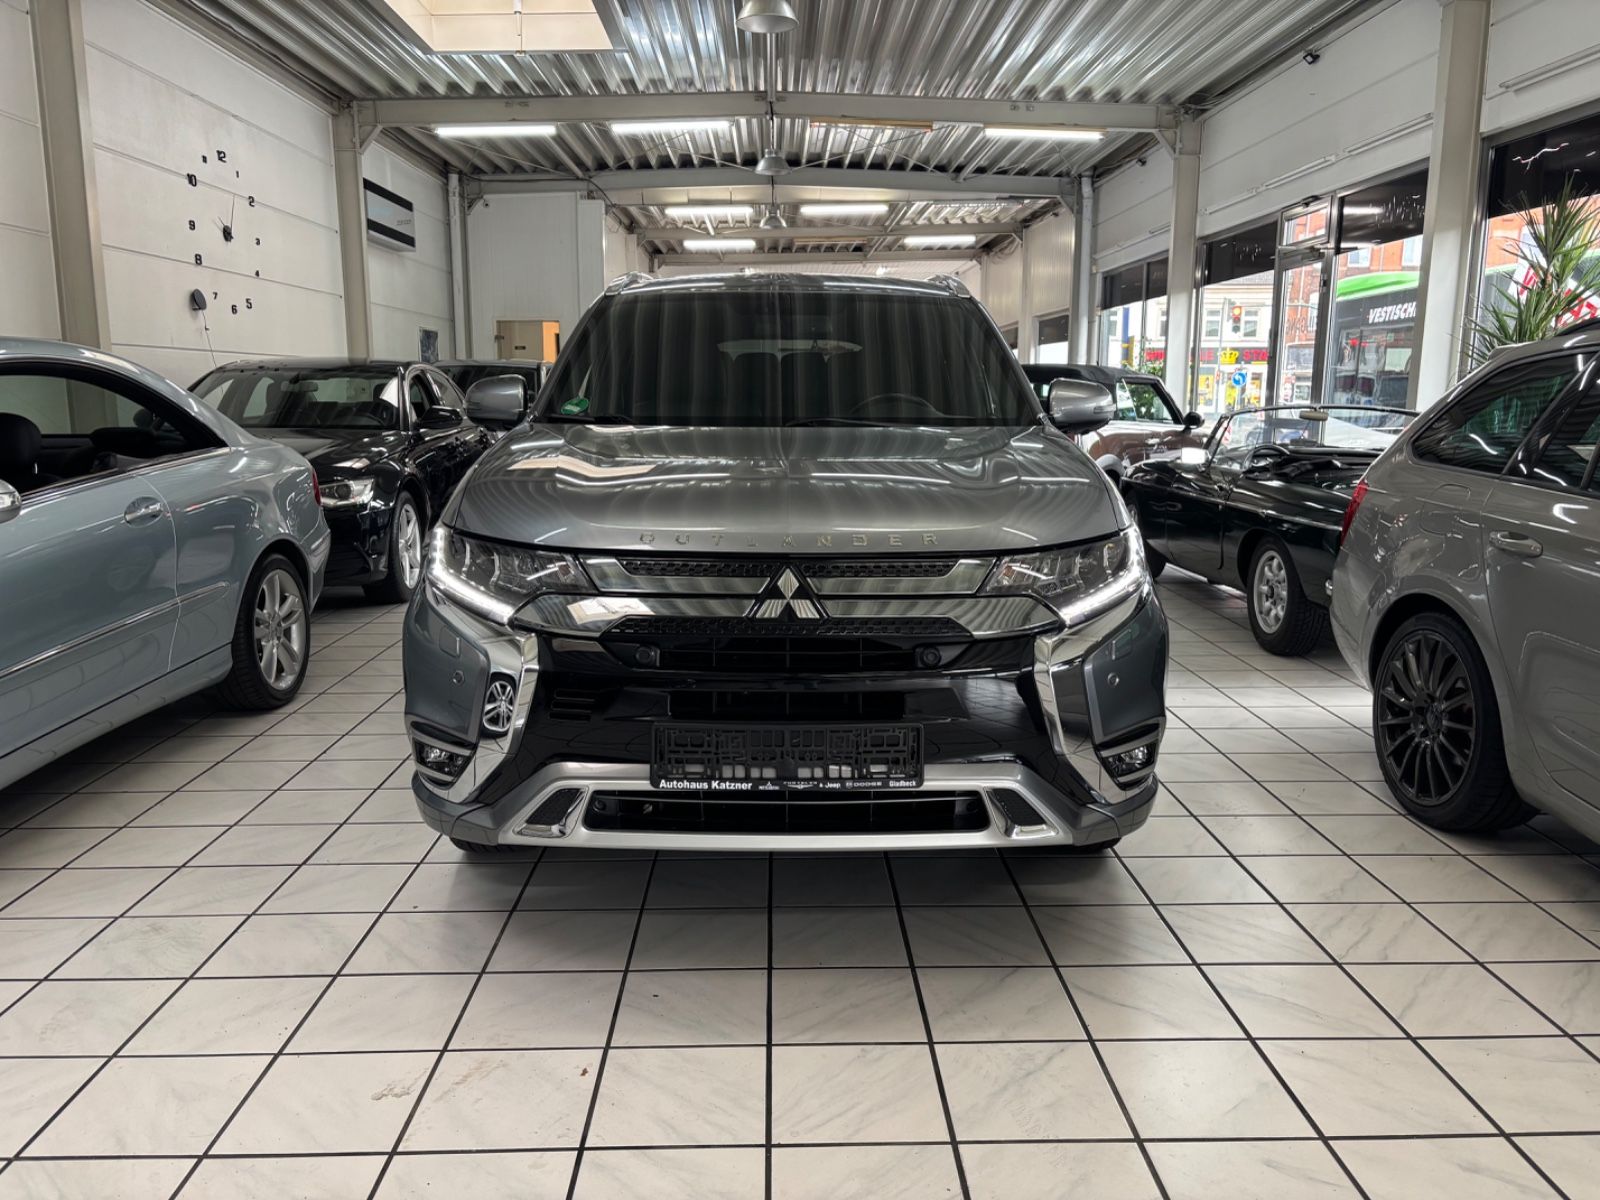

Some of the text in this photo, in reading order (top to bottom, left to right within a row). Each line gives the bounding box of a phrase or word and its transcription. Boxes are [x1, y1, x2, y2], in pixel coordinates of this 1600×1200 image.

[216, 150, 227, 163] 12
[187, 173, 197, 187] 10
[248, 196, 255, 207] 2
[188, 219, 196, 231] 9
[194, 253, 203, 266] 8
[212, 291, 218, 300] 7
[231, 304, 238, 315] 6
[245, 298, 253, 309] 5
[1369, 301, 1417, 324] VESTISCH
[640, 533, 938, 547] OUTLANDER
[659, 779, 708, 790] Autohaus
[711, 780, 753, 790] Katzner
